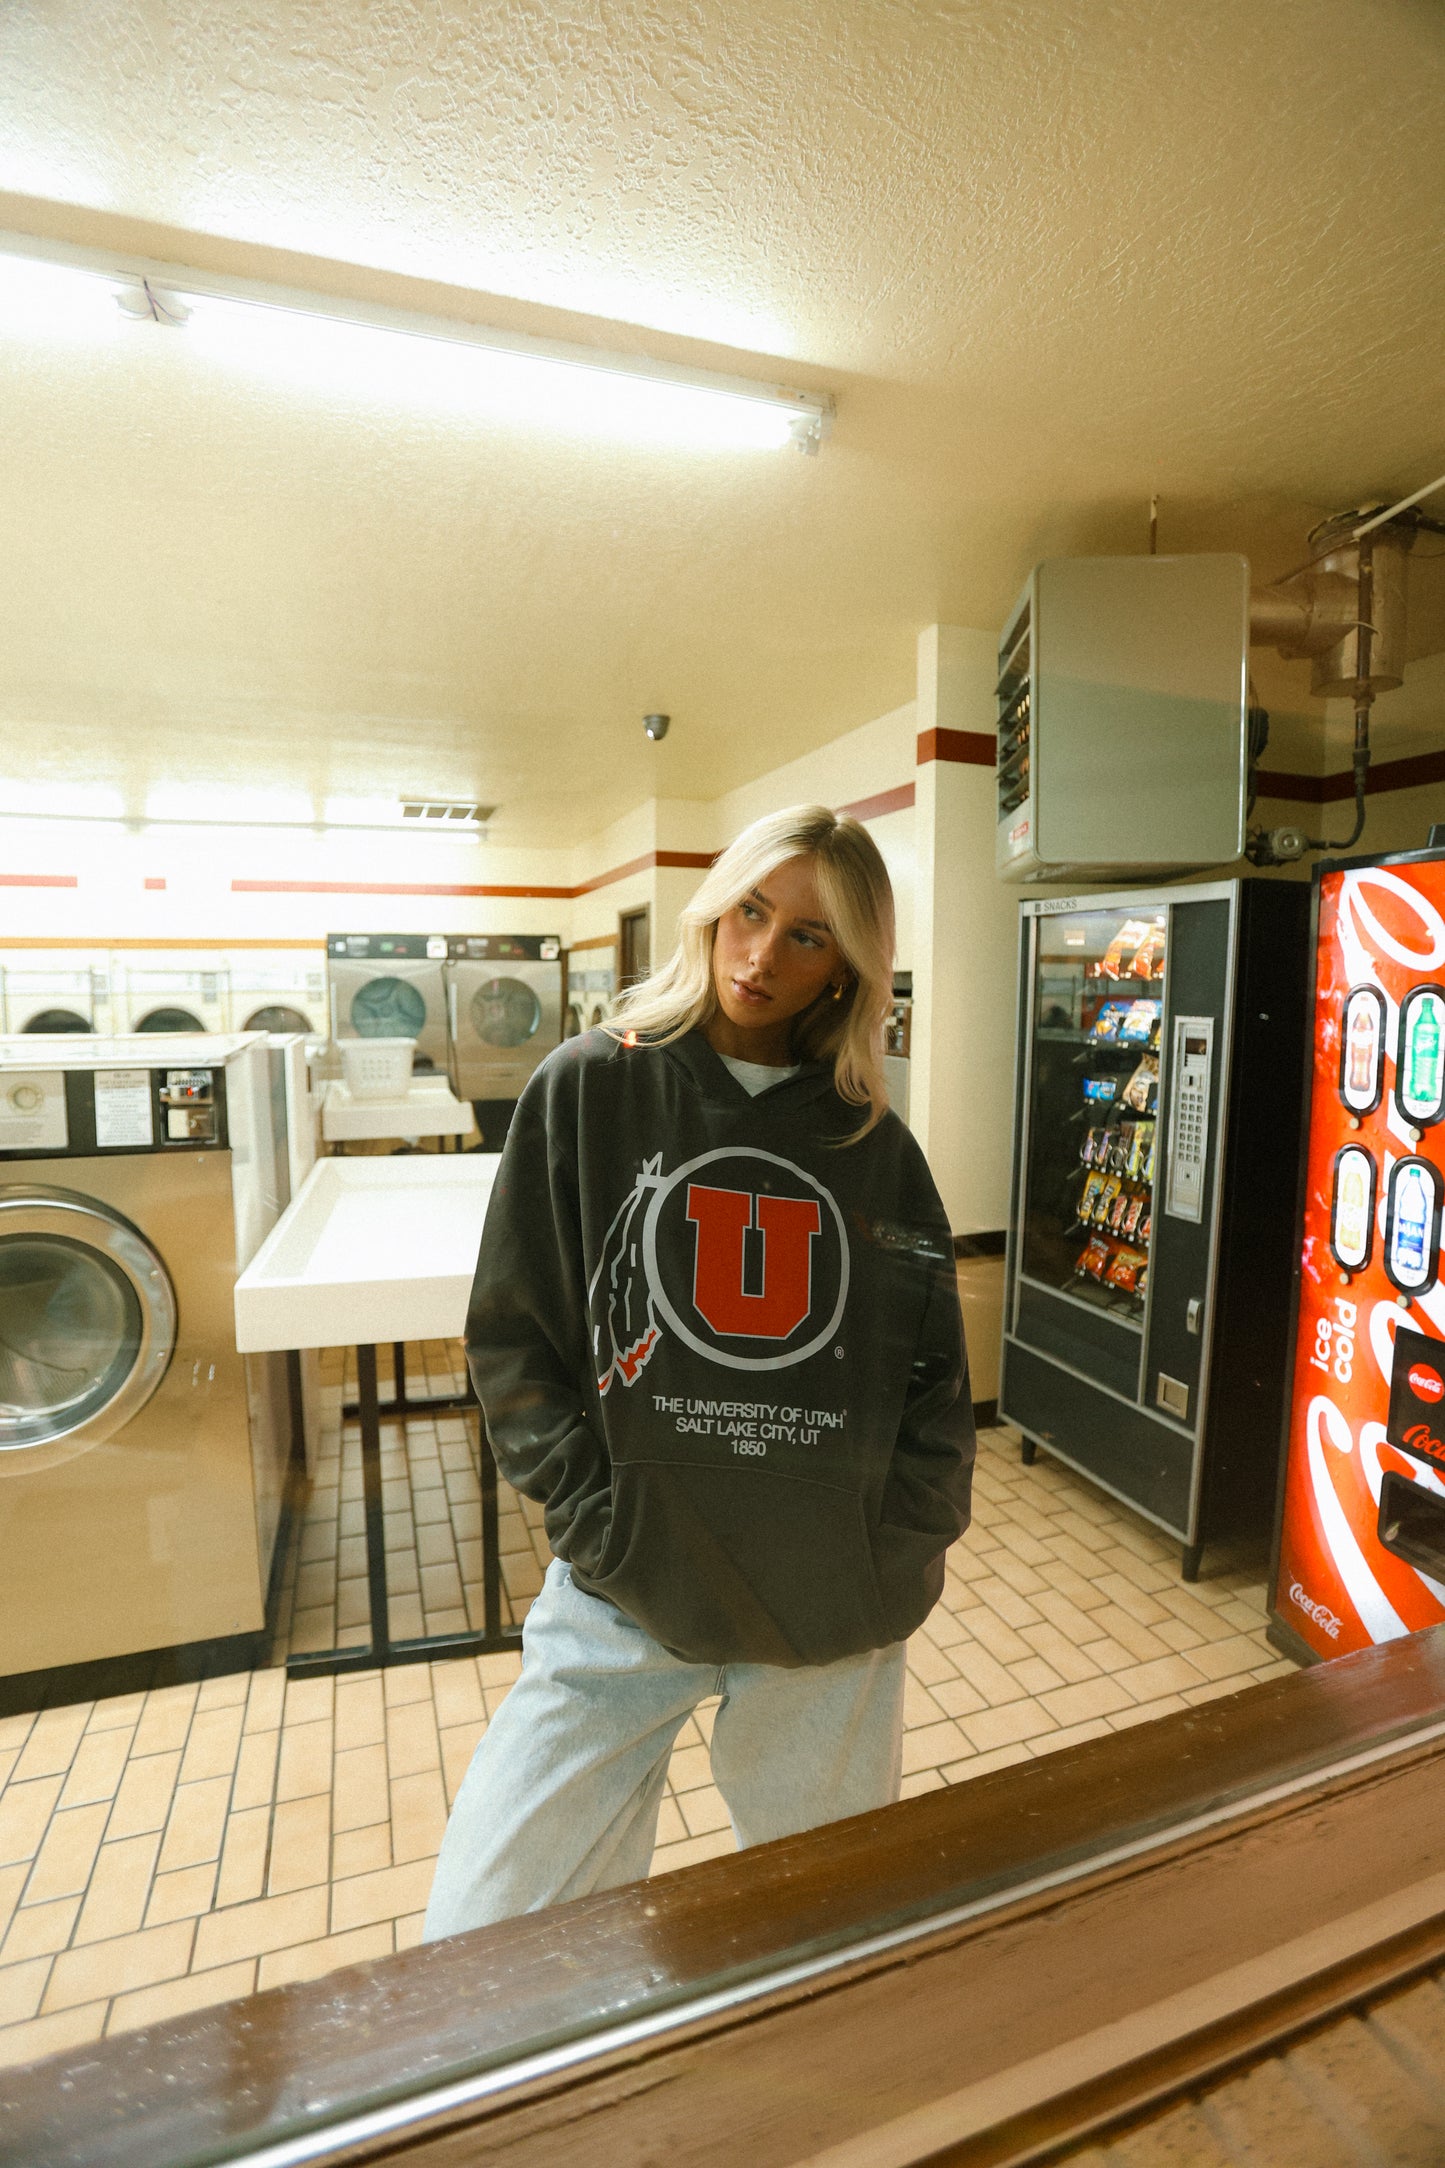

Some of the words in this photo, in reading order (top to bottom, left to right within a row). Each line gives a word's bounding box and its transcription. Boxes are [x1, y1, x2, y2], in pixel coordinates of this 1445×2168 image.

[1044, 899, 1077, 911] SNACKS
[685, 1183, 822, 1340] U
[1310, 1317, 1332, 1373] ice
[1334, 1296, 1357, 1384] cold
[652, 1395, 684, 1413] THE
[687, 1399, 778, 1420] UNIVERSITY
[780, 1407, 802, 1423] OF
[805, 1410, 844, 1428] UTAH
[675, 1417, 715, 1434] SALT
[717, 1420, 757, 1437] LAKE
[760, 1424, 796, 1444] CITY,
[800, 1428, 820, 1445] UT
[731, 1439, 766, 1456] 1850
